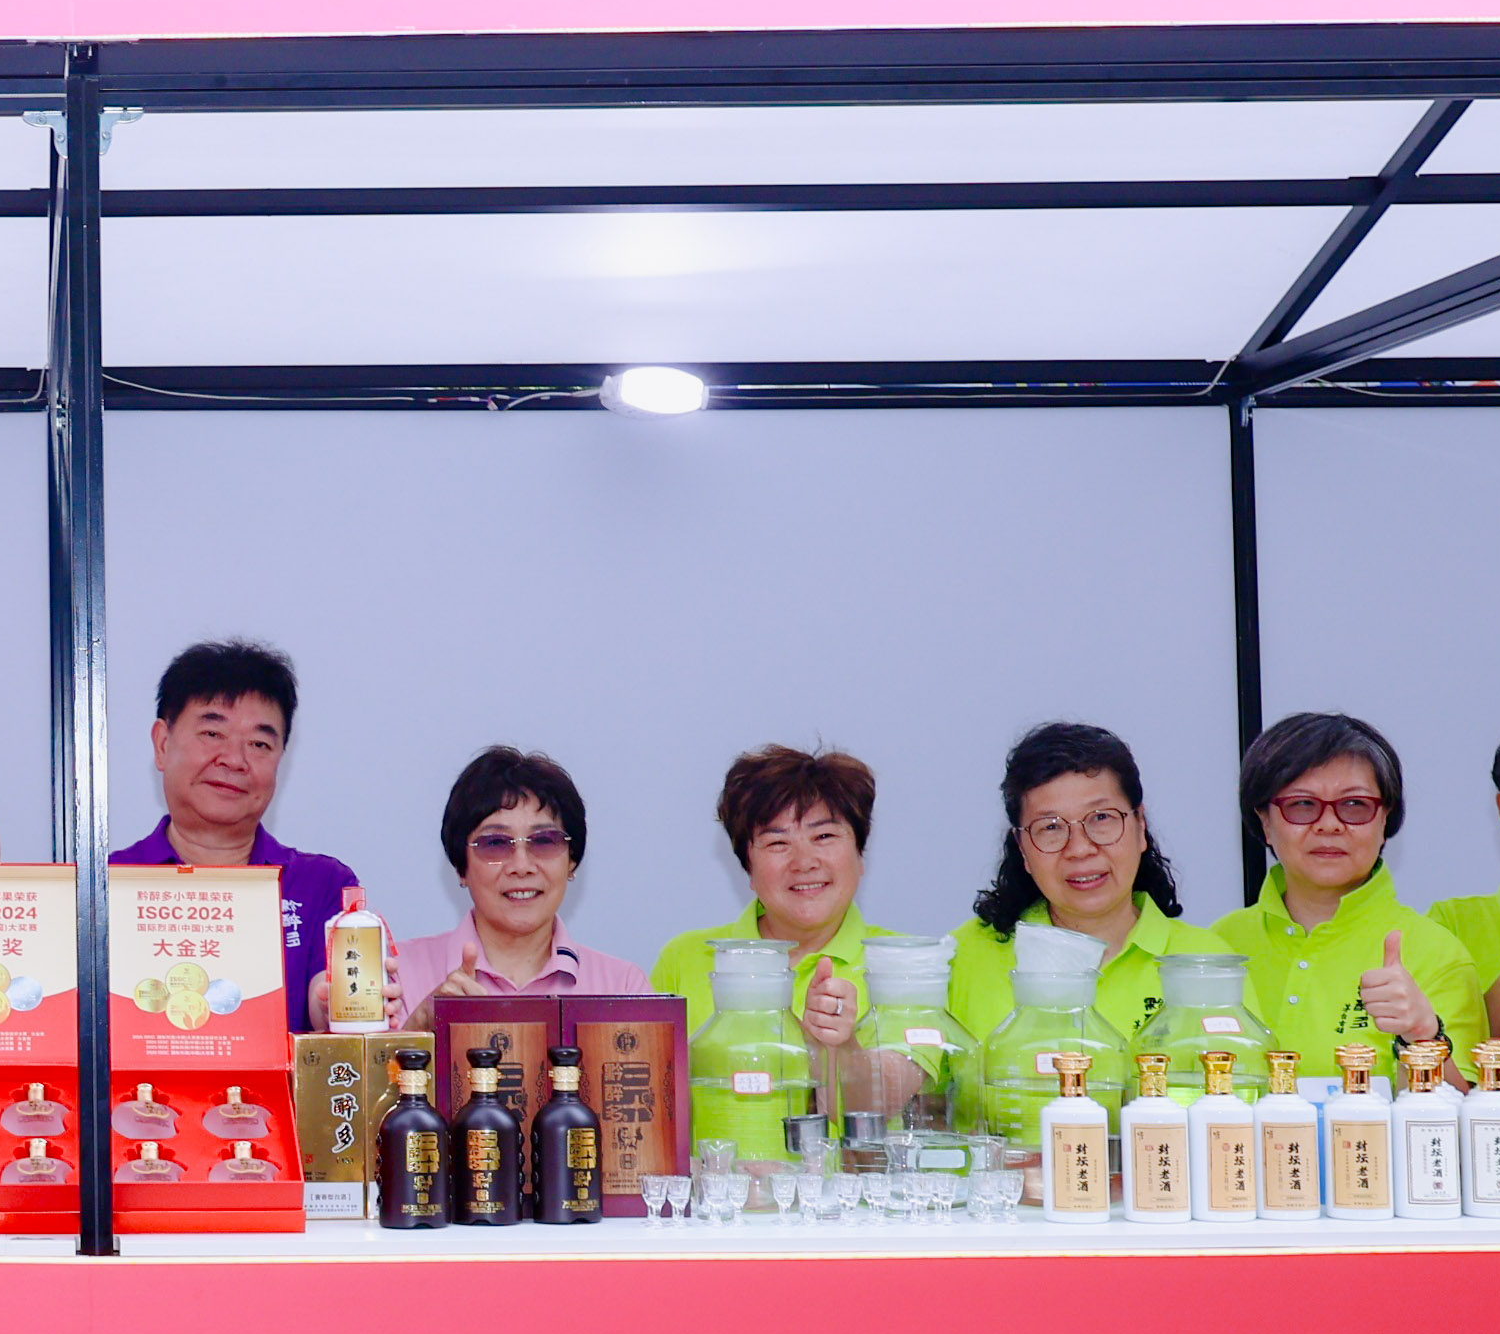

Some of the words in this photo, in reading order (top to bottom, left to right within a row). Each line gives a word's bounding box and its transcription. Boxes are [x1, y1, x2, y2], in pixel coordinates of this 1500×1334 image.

[136, 906, 184, 920] ISGC
[186, 906, 234, 920] 2024
[138, 891, 234, 902] 黔醉多小苹果荣获
[152, 938, 220, 957] 大金奖
[328, 1063, 360, 1154] 黔醉多
[1076, 1143, 1089, 1193] 封坛老酒
[1158, 1143, 1171, 1193] 封坛老酒
[1233, 1143, 1245, 1192] 封坛老酒
[1288, 1142, 1301, 1191] 封坛老酒
[1355, 1139, 1369, 1190] 封坛老酒
[1430, 1137, 1443, 1179] 封坛老酒
